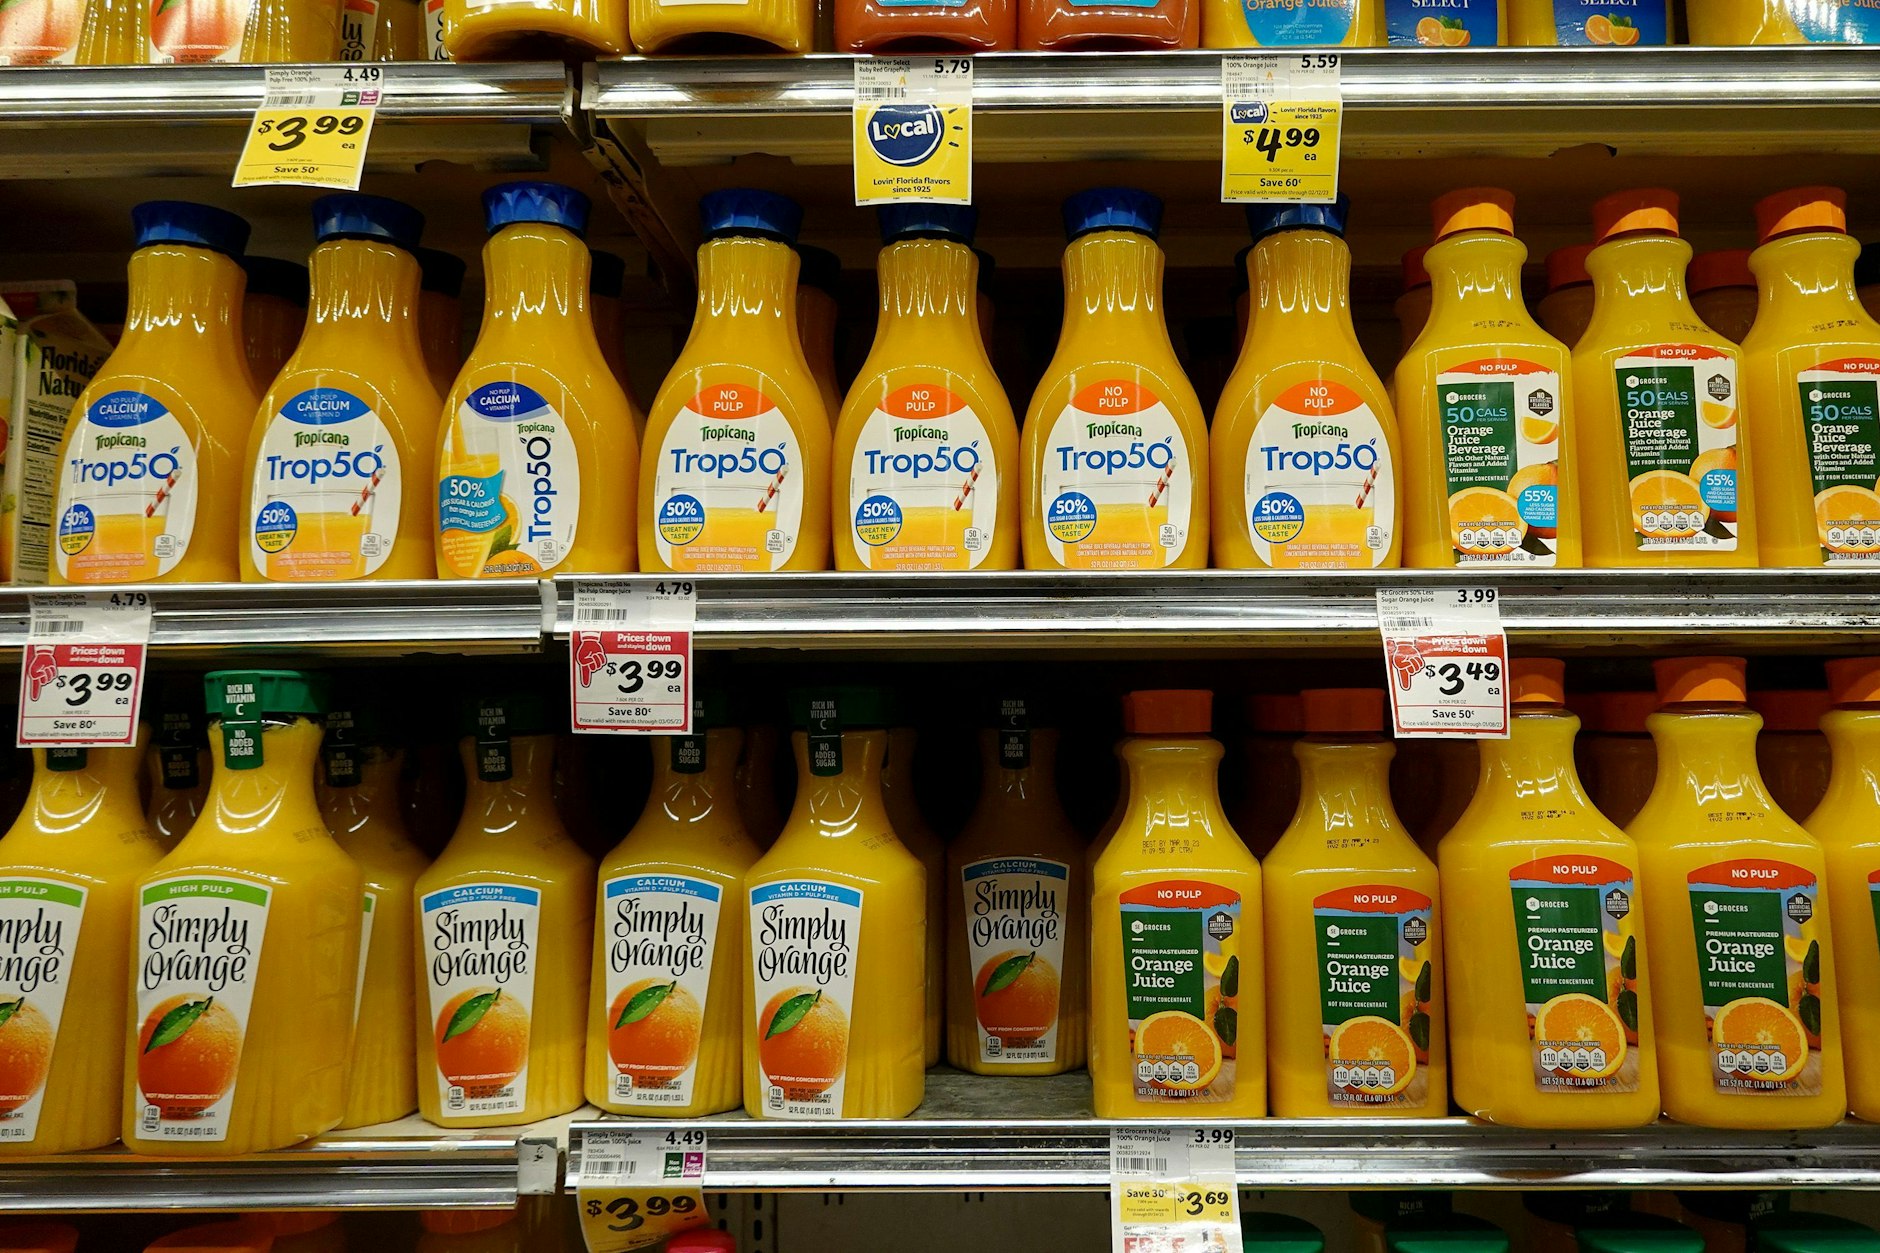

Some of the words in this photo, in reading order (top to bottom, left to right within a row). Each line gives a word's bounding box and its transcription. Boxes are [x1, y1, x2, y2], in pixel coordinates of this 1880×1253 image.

[935, 60, 970, 73] 5.79
[1301, 54, 1338, 68] 5.59
[344, 68, 380, 81] 4.49
[1260, 178, 1282, 186] Save
[720, 391, 737, 400] NO
[1310, 387, 1327, 396] NO
[297, 401, 350, 412] CALCIUM
[480, 395, 520, 406] CALCIUM
[714, 402, 743, 411] PULP
[1305, 399, 1334, 408] PULP
[1447, 407, 1474, 423] 50
[1476, 408, 1507, 417] CALS
[1628, 409, 1675, 419] Orange
[517, 423, 555, 434] Tropicana
[1087, 421, 1142, 438] Tropicana
[1292, 422, 1348, 438] Tropicana
[1628, 418, 1662, 429] Juice
[700, 425, 755, 441] Tropicana
[1447, 425, 1493, 436] Orange
[1629, 428, 1687, 439] Beverage
[96, 433, 146, 450] Tropicana
[294, 430, 349, 447] Tropicana
[1448, 435, 1480, 445] Juice
[1448, 445, 1505, 455] Beverage
[671, 448, 785, 478] Trop50
[1057, 442, 1173, 475] Trop50
[1261, 443, 1377, 475] Trop50
[71, 453, 178, 486] Trop50
[267, 451, 383, 484] Trop50
[450, 479, 484, 497] 50%
[1524, 490, 1554, 502] 55%
[1261, 499, 1295, 514] 50%
[262, 508, 290, 523] 50%
[656, 582, 692, 595] 4.79
[111, 593, 146, 606] 4.79
[1458, 589, 1495, 603] 3.99
[617, 633, 644, 642] Prices
[646, 634, 671, 642] down
[646, 642, 671, 651] down
[227, 685, 243, 694] RICH
[244, 684, 253, 693] IN
[226, 694, 255, 703] VITAMIN
[235, 704, 244, 715] C
[608, 707, 632, 716] Save
[1432, 710, 1456, 718] Save
[54, 720, 76, 729] Save
[235, 730, 246, 738] NO
[229, 739, 253, 747] ADDED
[230, 747, 254, 756] SUGAR
[1552, 865, 1569, 874] NO
[1572, 865, 1597, 875] PULP
[169, 885, 198, 894] HIGH
[202, 885, 233, 894] PULP
[637, 879, 686, 887] CALCIUM
[779, 883, 826, 892] CALCIUM
[973, 879, 1060, 920] Simply
[1157, 890, 1173, 899] NO
[1176, 890, 1202, 899] PULP
[614, 897, 707, 945] Simply
[148, 904, 251, 953] Simply
[759, 903, 849, 953] Simply
[972, 916, 1057, 948] Orange
[1527, 936, 1593, 953] Orange
[1705, 939, 1774, 957] Orange
[611, 937, 704, 977] Orange
[1530, 953, 1575, 969] Juice
[144, 949, 246, 992] Orange
[758, 945, 848, 985] Orange
[1131, 957, 1193, 971] Orange
[1708, 957, 1755, 973] Juice
[1132, 973, 1175, 988] Juice
[666, 1131, 704, 1145] 4.49
[1195, 1129, 1233, 1143] 3.99
[1127, 1189, 1149, 1197] Save
